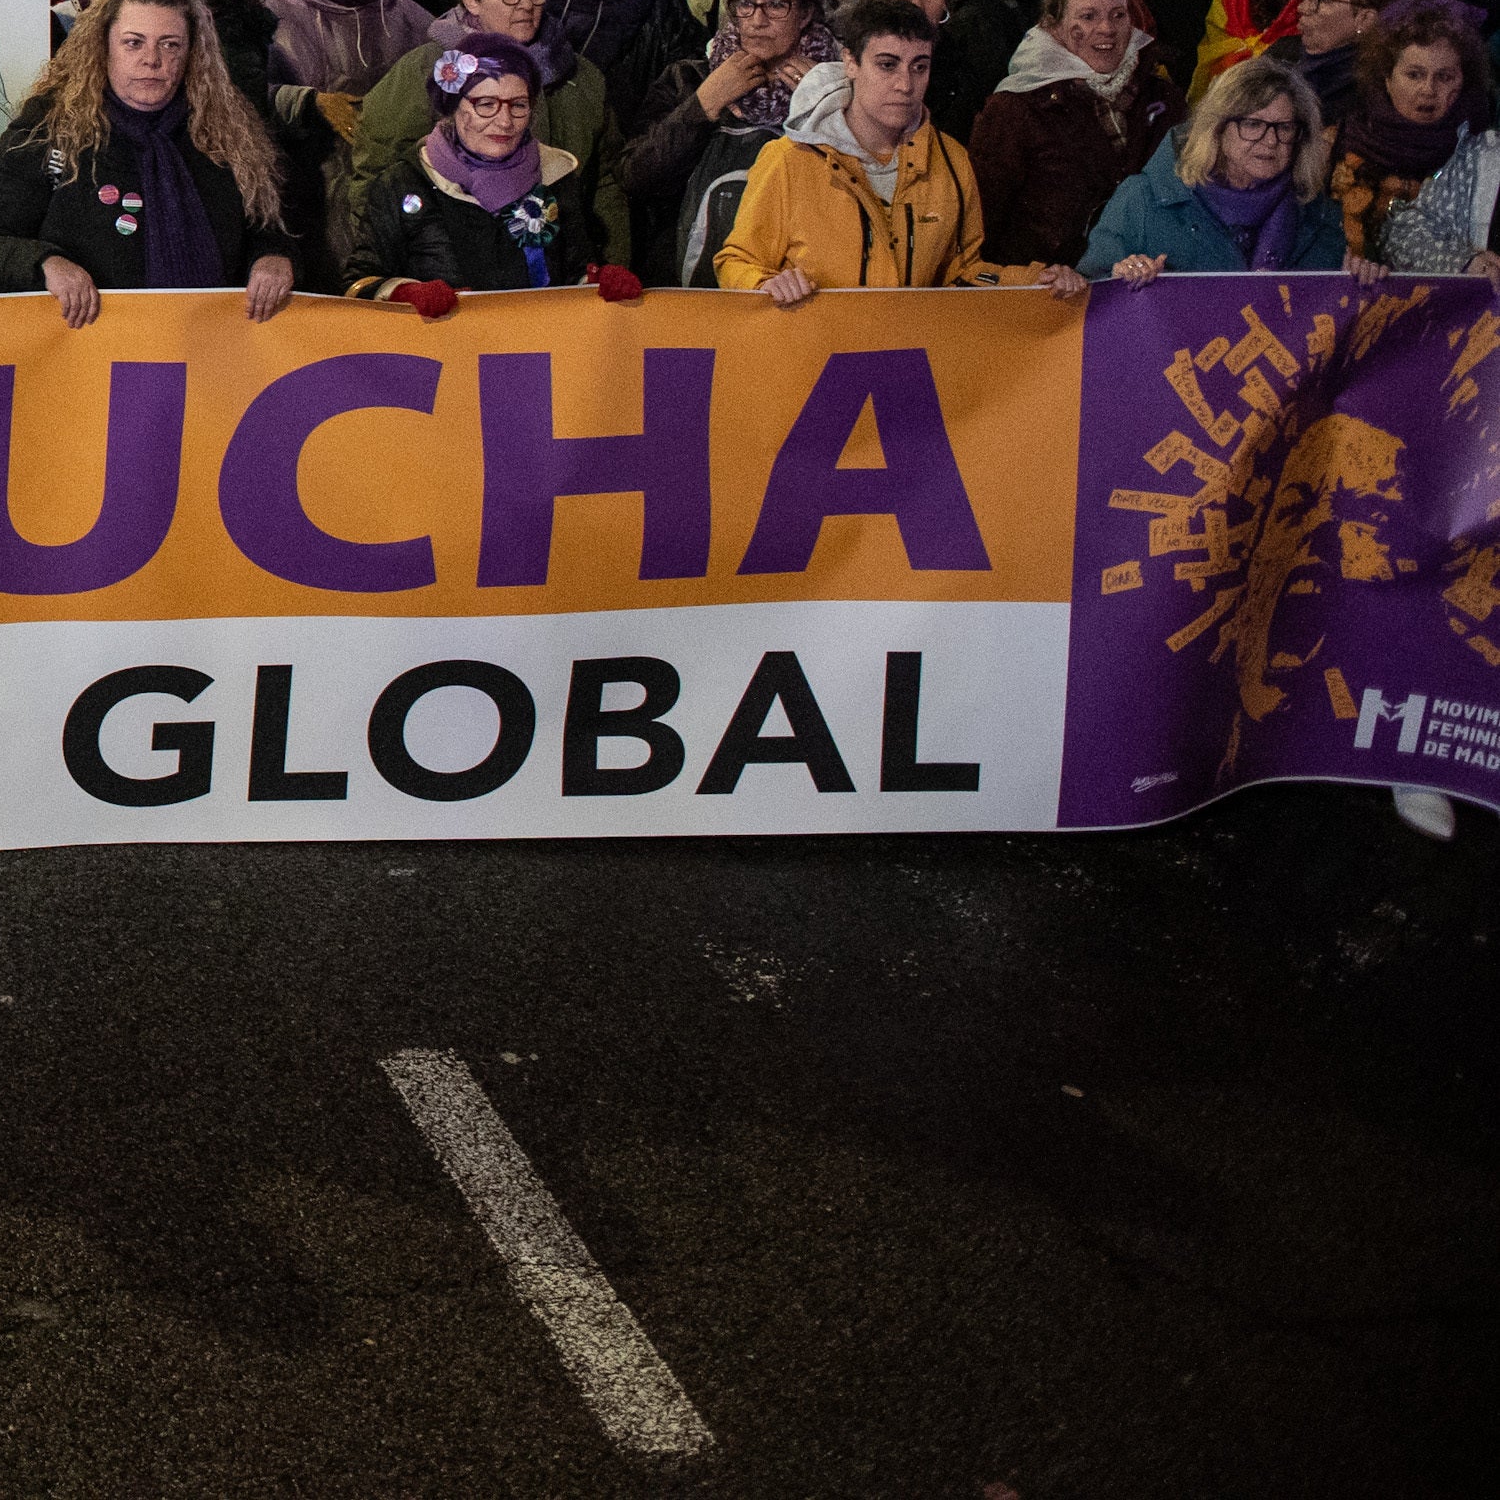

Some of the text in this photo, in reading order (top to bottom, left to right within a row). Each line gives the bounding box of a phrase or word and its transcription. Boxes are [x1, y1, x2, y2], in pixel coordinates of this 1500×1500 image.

[1432, 699, 1500, 726] MOVIM
[61, 650, 982, 807] GLOBAL
[1422, 740, 1451, 759] DE
